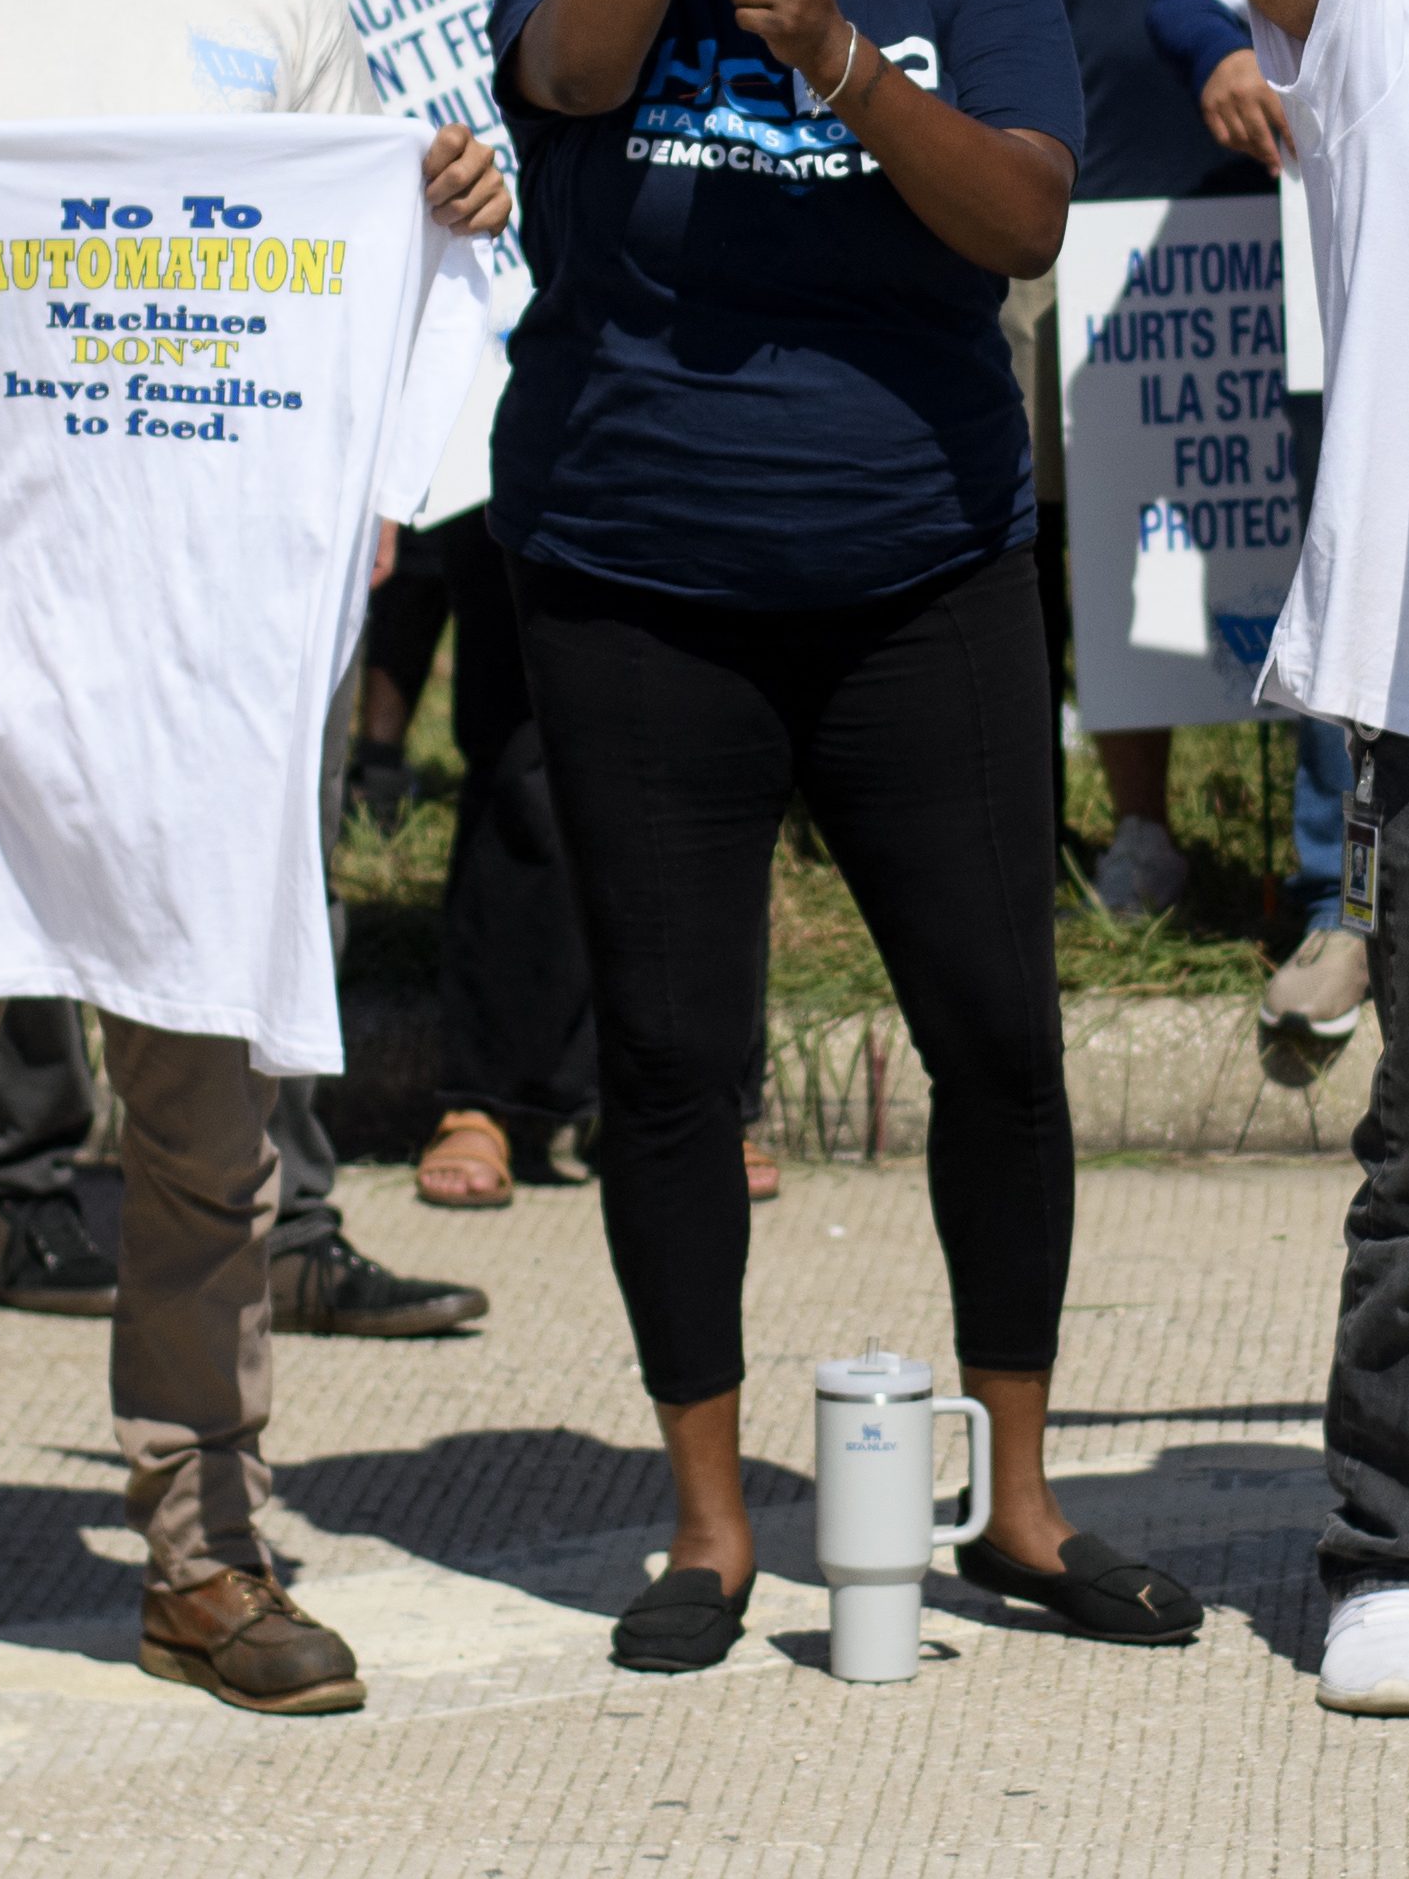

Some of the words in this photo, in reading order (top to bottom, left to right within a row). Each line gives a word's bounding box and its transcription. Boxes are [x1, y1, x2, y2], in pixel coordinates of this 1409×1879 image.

[648, 109, 781, 147] HARRIS
[626, 136, 849, 181] DEMOCRATIC
[61, 197, 153, 230] No
[182, 196, 262, 229] To
[47, 302, 267, 334] Machines
[1087, 308, 1215, 363] HURTS
[71, 335, 239, 369] DON'T
[3, 372, 110, 401] have
[125, 373, 303, 410] families
[1141, 373, 1203, 425] ILA
[64, 412, 109, 436] to
[125, 409, 240, 442] feed.
[1176, 434, 1251, 488] FOR
